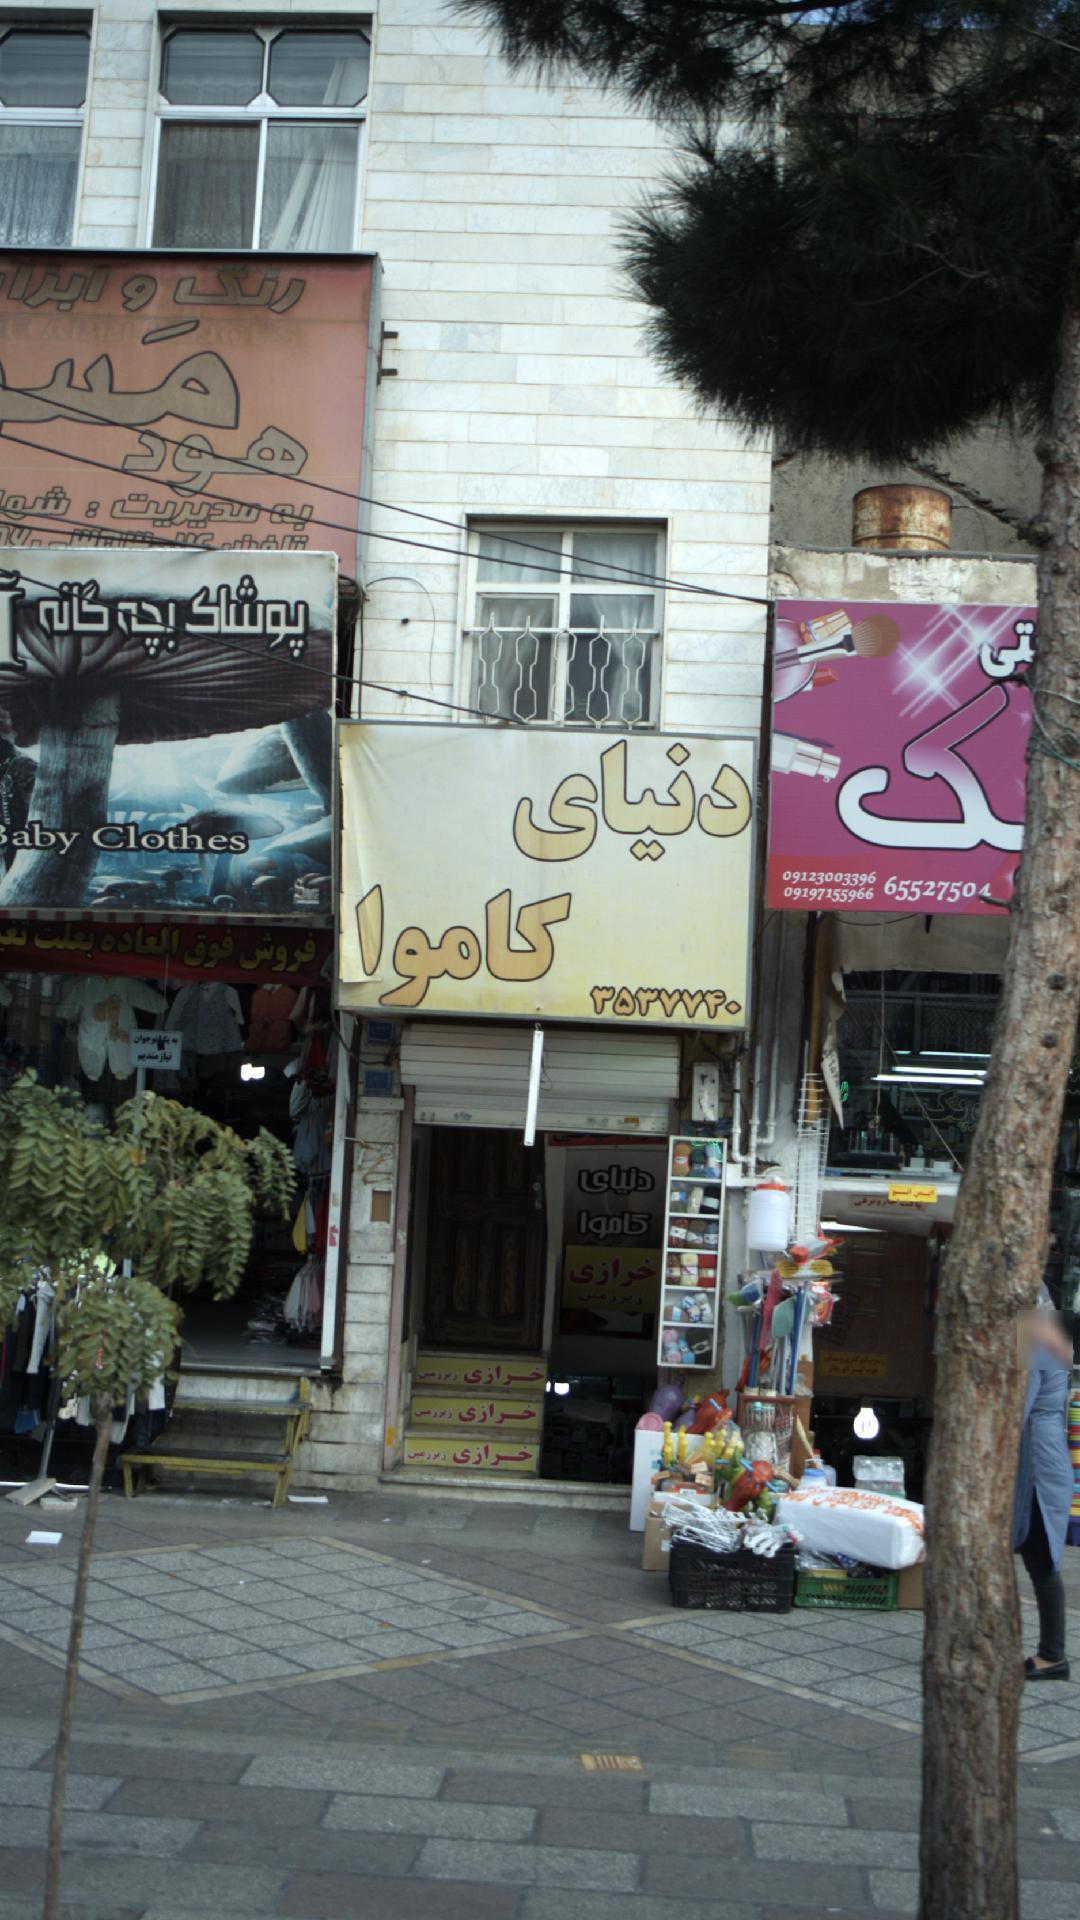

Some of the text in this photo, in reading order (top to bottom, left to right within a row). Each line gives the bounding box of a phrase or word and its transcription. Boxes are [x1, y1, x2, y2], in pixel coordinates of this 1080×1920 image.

[0, 263, 306, 314] رنگ و ابزا
[121, 425, 308, 497] هود
[110, 493, 261, 529] مدیریت
[270, 503, 314, 531] به
[117, 597, 176, 656] بچه
[185, 575, 305, 658] پوشاک
[513, 739, 752, 862] دنیای
[92, 823, 247, 853] Clothes
[782, 870, 877, 887] 09123003396
[784, 887, 875, 903] 09197155966
[101, 926, 180, 957] العاده
[183, 926, 235, 968] فوق
[239, 930, 317, 973] فروش
[356, 884, 572, 1007] کاموا
[590, 985, 742, 1019] ۳۵۳۷۷۴۰
[578, 1165, 655, 1194] دنیای
[577, 1210, 653, 1240] کاموا
[569, 1256, 657, 1287] خرازی
[463, 1365, 545, 1386] خرازی
[458, 1402, 537, 1424] خرازی
[452, 1444, 533, 1466] خرازی
